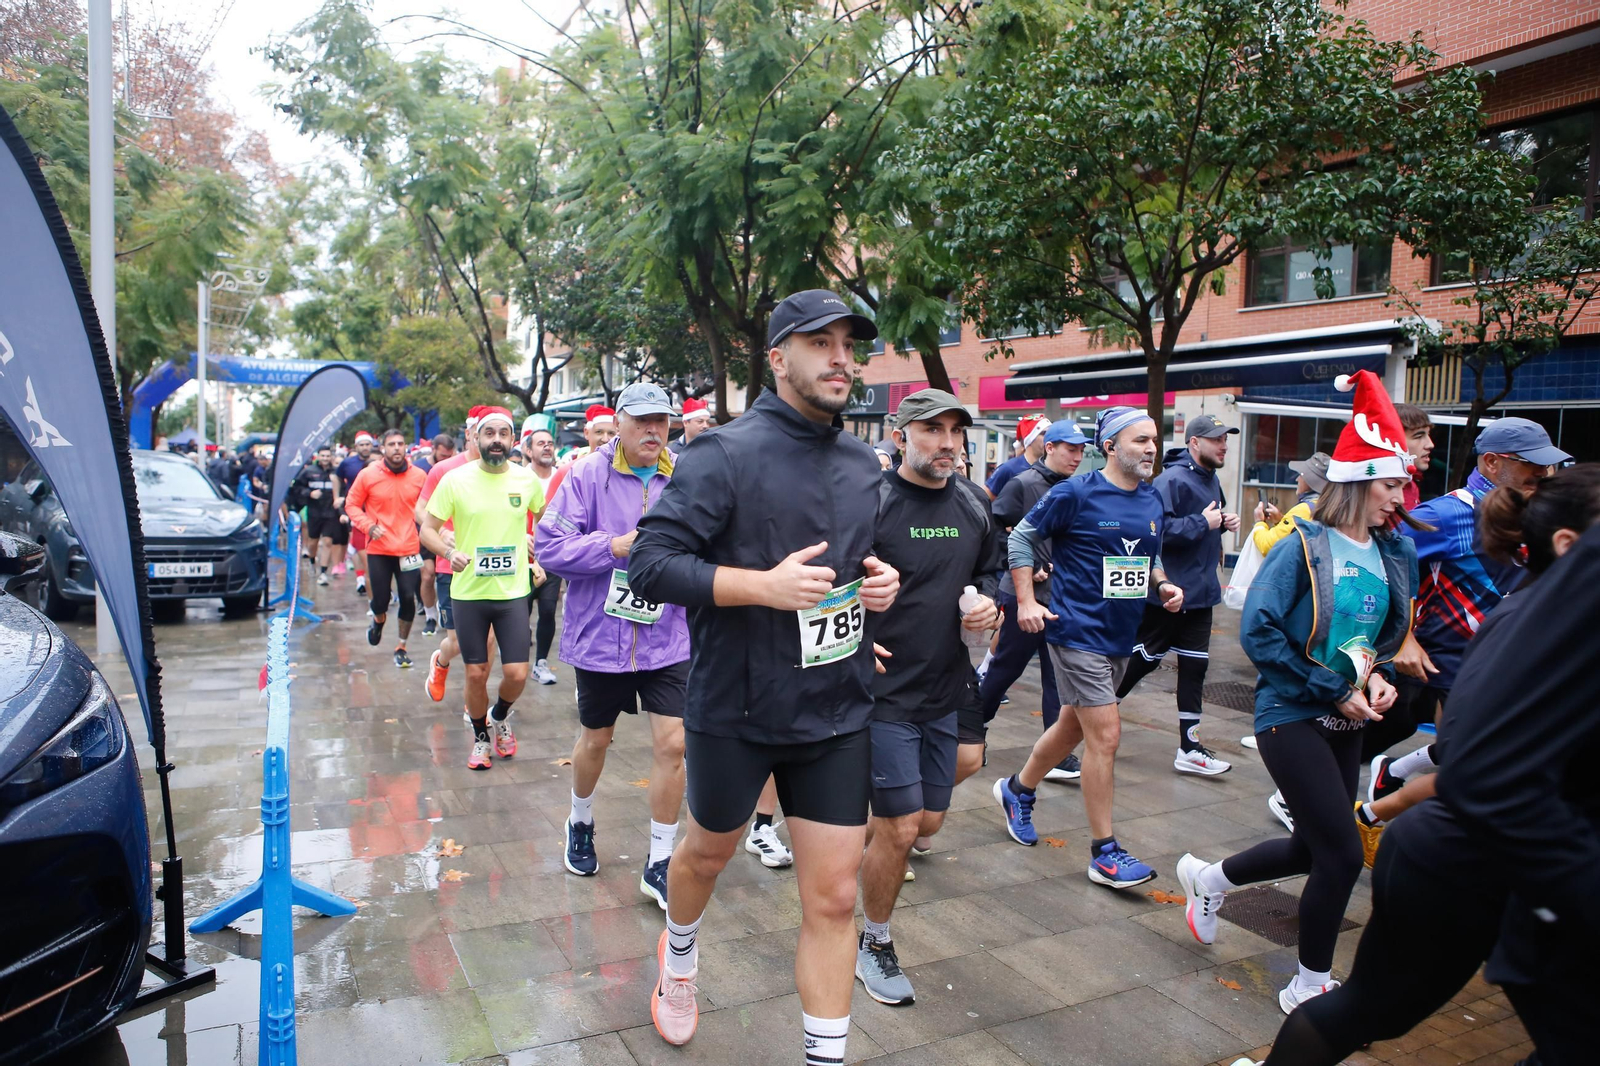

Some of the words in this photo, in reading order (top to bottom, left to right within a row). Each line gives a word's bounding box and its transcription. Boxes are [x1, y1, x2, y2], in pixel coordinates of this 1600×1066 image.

[249, 372, 264, 381] DE
[303, 396, 357, 447] CUPRA
[909, 526, 959, 540] kipsta
[479, 556, 512, 569] 455
[1109, 570, 1145, 587] 265
[808, 603, 862, 647] 785
